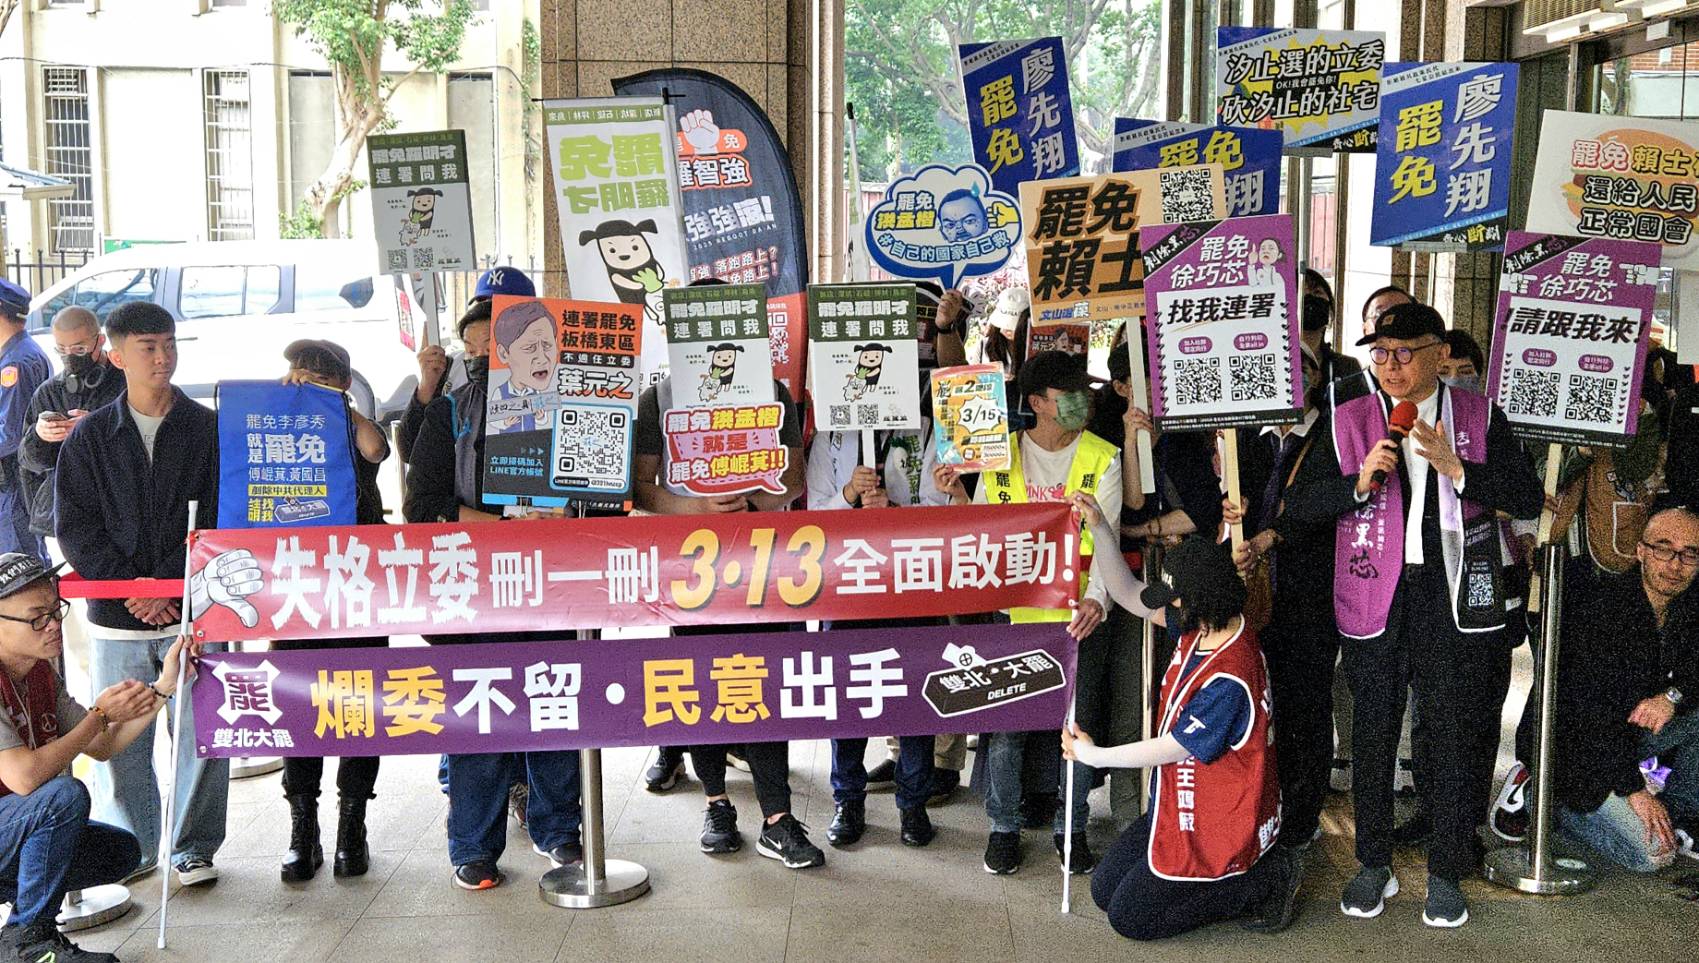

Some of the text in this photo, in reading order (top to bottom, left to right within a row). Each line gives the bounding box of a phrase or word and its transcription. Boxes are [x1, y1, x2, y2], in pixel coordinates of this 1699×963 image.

[1224, 39, 1385, 84] 汐止選的立委
[1021, 46, 1066, 179] 廖先翔
[1221, 81, 1379, 125] 砍汐止的社宅
[979, 75, 1024, 174] 罷免
[1388, 99, 1444, 204] 罷免
[1444, 72, 1505, 217] 廖先翔
[1572, 139, 1699, 174] 罷免賴士
[376, 163, 458, 184] 連署問我
[897, 191, 934, 210] 罷免
[1584, 176, 1699, 211] 還給人民
[684, 196, 775, 242] 強強滾!
[1032, 182, 1140, 242] 罷免
[1577, 208, 1693, 245] 正常國會
[1199, 235, 1250, 262] 罷免
[1169, 260, 1246, 289] 徐巧芯
[1560, 251, 1614, 278] 罷免
[1539, 274, 1618, 302] 徐巧芯
[562, 310, 637, 331] 連署罷免
[818, 300, 909, 317] 罷免羅明才
[1166, 293, 1276, 325] 找我連署
[561, 331, 635, 352] 板橋東區
[674, 318, 760, 339] 連署問我
[821, 319, 909, 338] 連署問我
[558, 368, 634, 400] 葉元之
[962, 404, 997, 425] 3/15
[264, 433, 326, 464] 罷免
[703, 432, 748, 453] 就是
[270, 530, 479, 630] 失格立委
[489, 546, 660, 608] 刪一刪
[833, 530, 1075, 597] 全面啟動!
[988, 683, 1027, 700] DELETE
[211, 727, 295, 750] 雙北大罷
